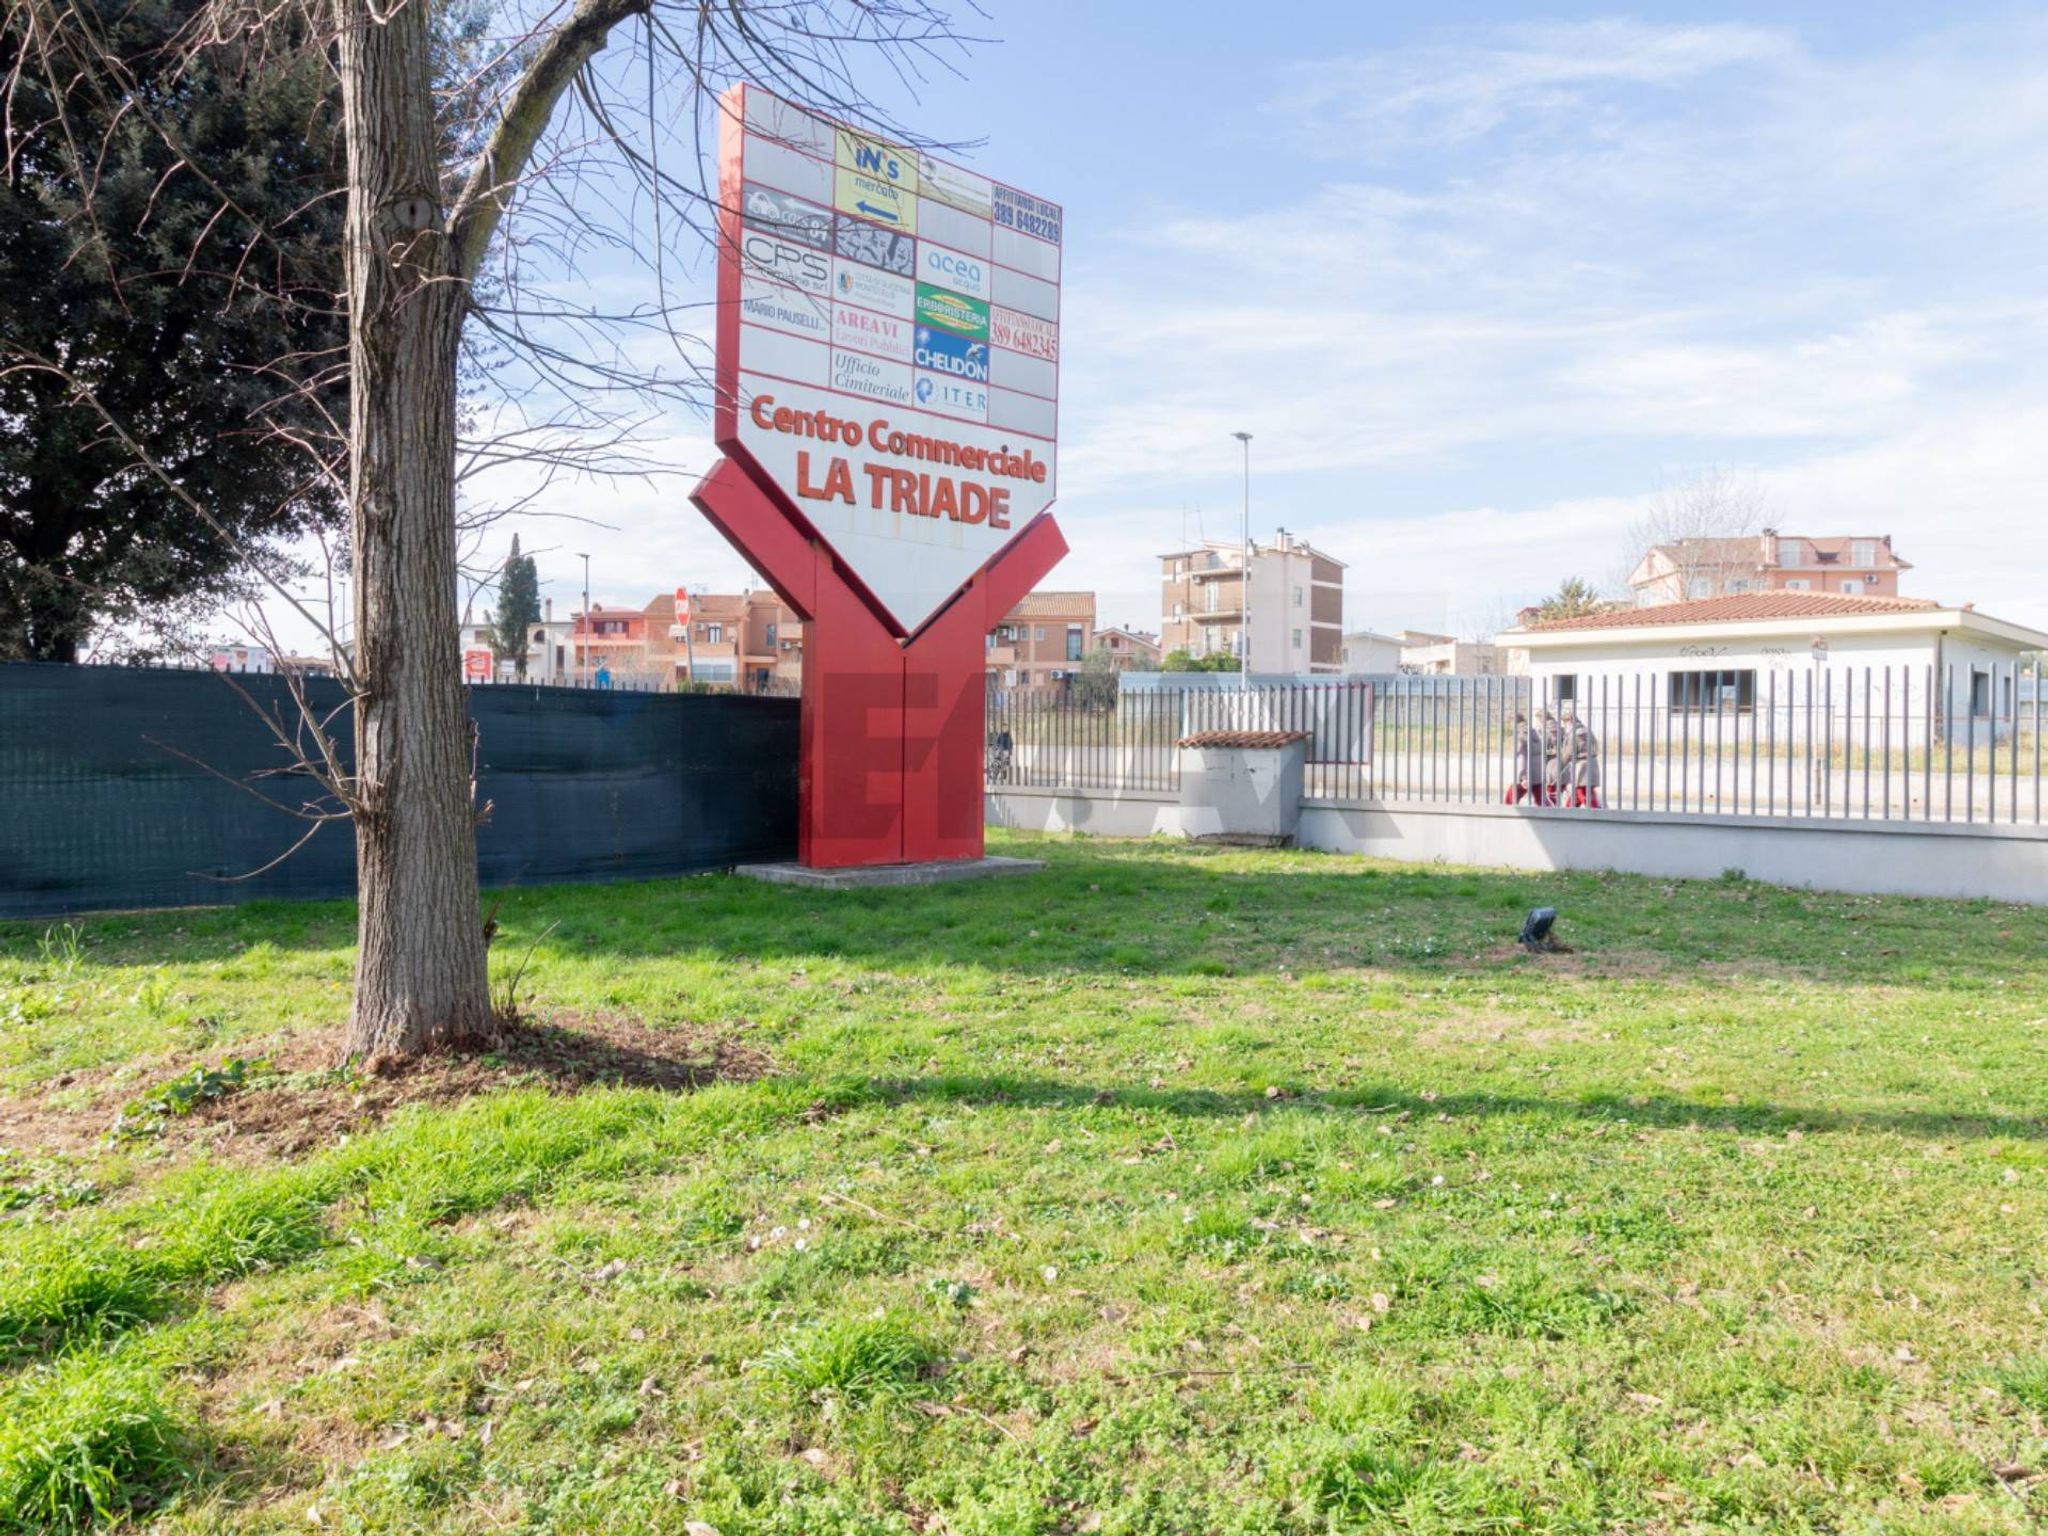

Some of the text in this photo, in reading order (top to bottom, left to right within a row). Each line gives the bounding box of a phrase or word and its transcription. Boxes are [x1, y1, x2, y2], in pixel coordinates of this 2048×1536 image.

[855, 176, 899, 200] mercato
[994, 201, 1013, 226] 389
[746, 237, 828, 281] CPS
[928, 251, 981, 283] acea
[743, 299, 819, 330] MARIO PAUSELLI
[836, 310, 897, 339] AREA VI
[917, 296, 989, 327] ERBORISTERIA
[835, 353, 880, 378] Ufficio
[915, 348, 988, 382] CHELIDON
[834, 372, 911, 402] Cimiteriale
[943, 386, 986, 410] ITER
[751, 395, 1047, 484] Centro Commerciale
[797, 450, 1011, 530] LA TRIADE
